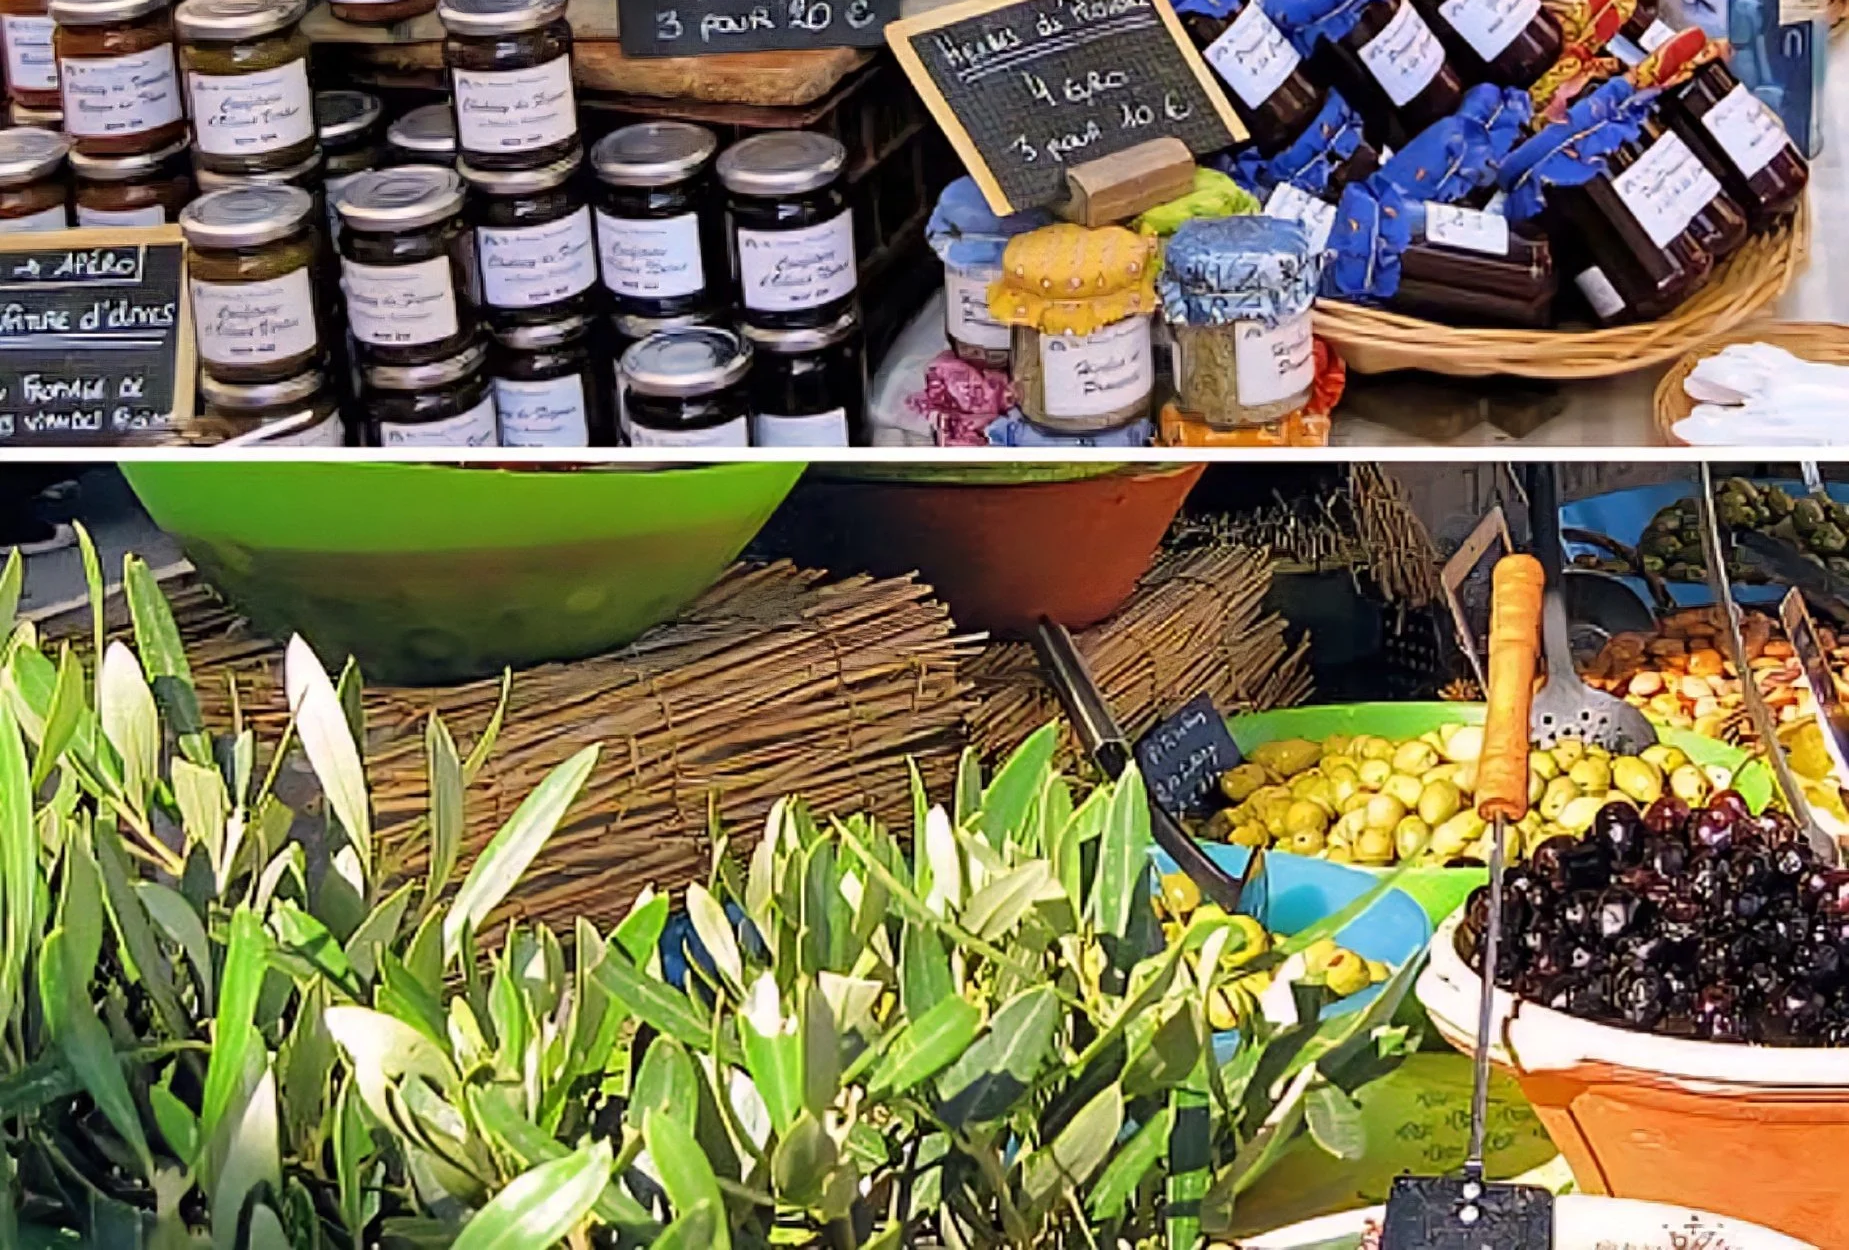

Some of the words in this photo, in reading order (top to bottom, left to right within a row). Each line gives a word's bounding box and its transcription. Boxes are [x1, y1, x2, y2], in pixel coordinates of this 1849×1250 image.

[657, 10, 684, 39] 3
[1020, 70, 1056, 107] 4
[1010, 134, 1038, 162] 3
